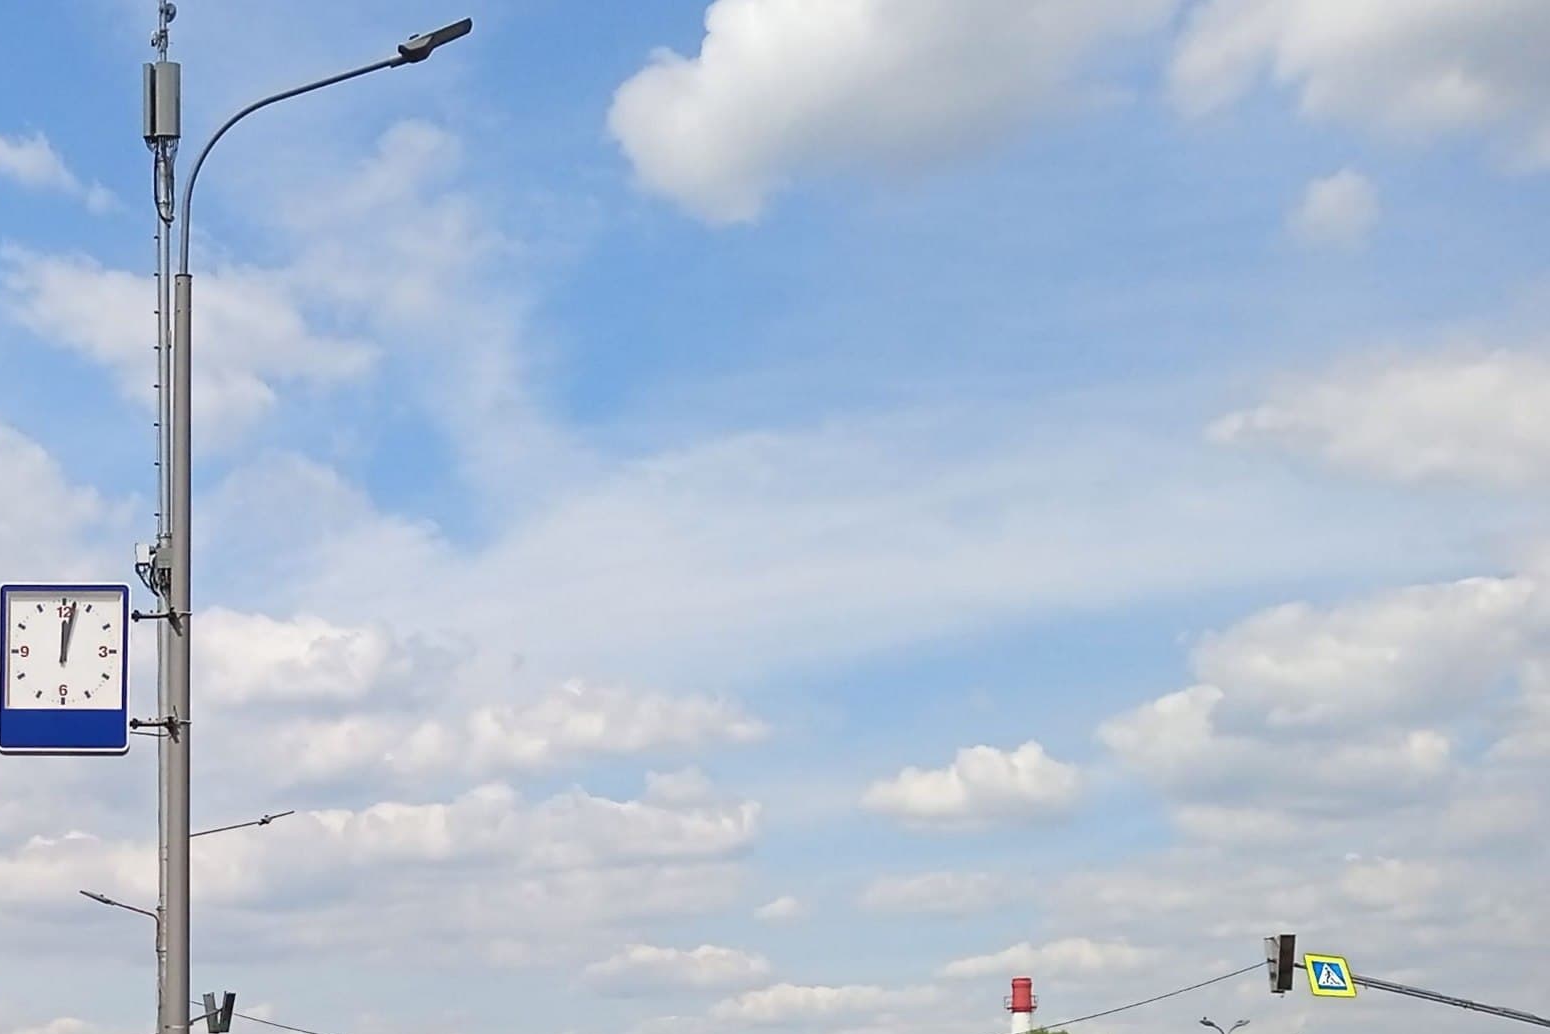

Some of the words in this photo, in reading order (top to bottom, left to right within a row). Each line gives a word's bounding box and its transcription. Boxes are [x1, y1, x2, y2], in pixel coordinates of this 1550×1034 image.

[57, 606, 74, 618] 12
[20, 646, 29, 657] 9
[98, 646, 108, 658] 3
[59, 685, 68, 696] 6
